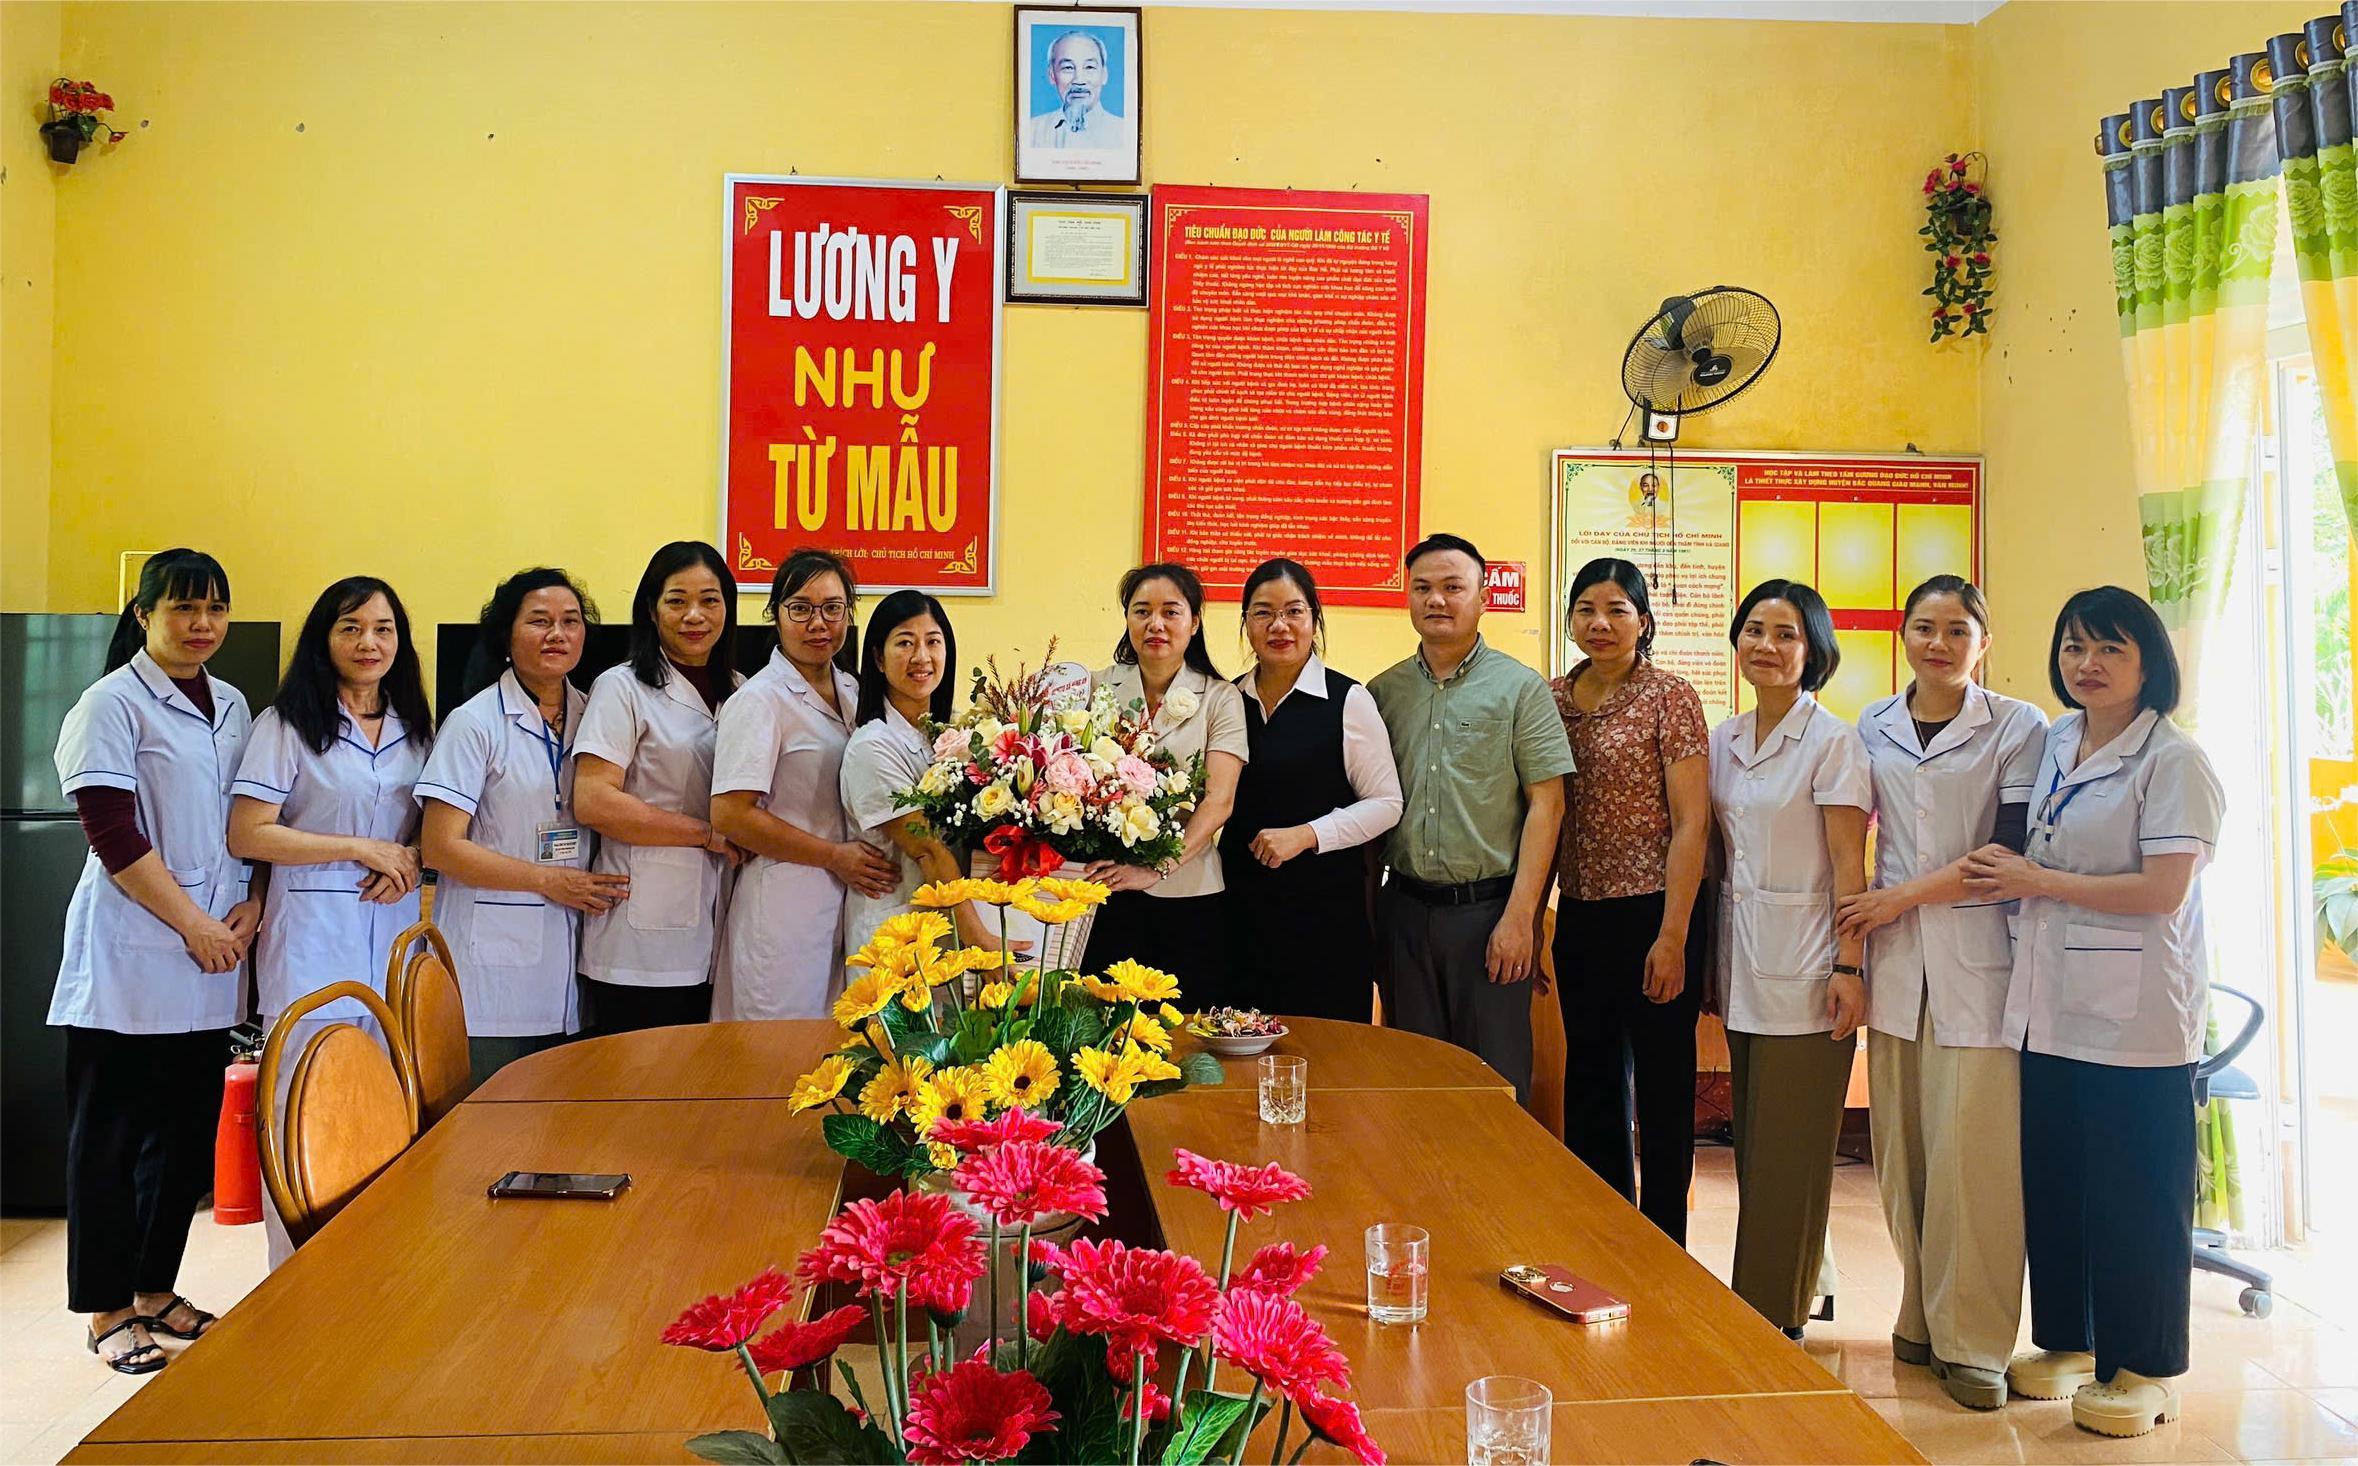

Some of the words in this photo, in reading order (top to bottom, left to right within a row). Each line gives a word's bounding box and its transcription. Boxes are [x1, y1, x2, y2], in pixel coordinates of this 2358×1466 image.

[1185, 224, 1201, 238] TIÊU
[1232, 228, 1248, 241] ĐẠO
[1270, 225, 1286, 241] CỦA
[1315, 228, 1332, 242] LÀM
[1334, 228, 1355, 243] CÔNG
[1357, 229, 1372, 243] TÁC
[1374, 232, 1380, 244] Y
[768, 222, 916, 322] LƯƠNG
[932, 236, 960, 323] Y
[794, 341, 936, 411] NHƯ
[768, 425, 837, 532] TỪ
[846, 414, 958, 533] MẪU
[871, 547, 886, 559] CHỦ
[889, 550, 906, 559] TỊCH
[907, 547, 918, 559] HỒ
[920, 548, 932, 559] CHÍ
[934, 551, 955, 559] MINH
[1492, 589, 1519, 605] THUỐC
